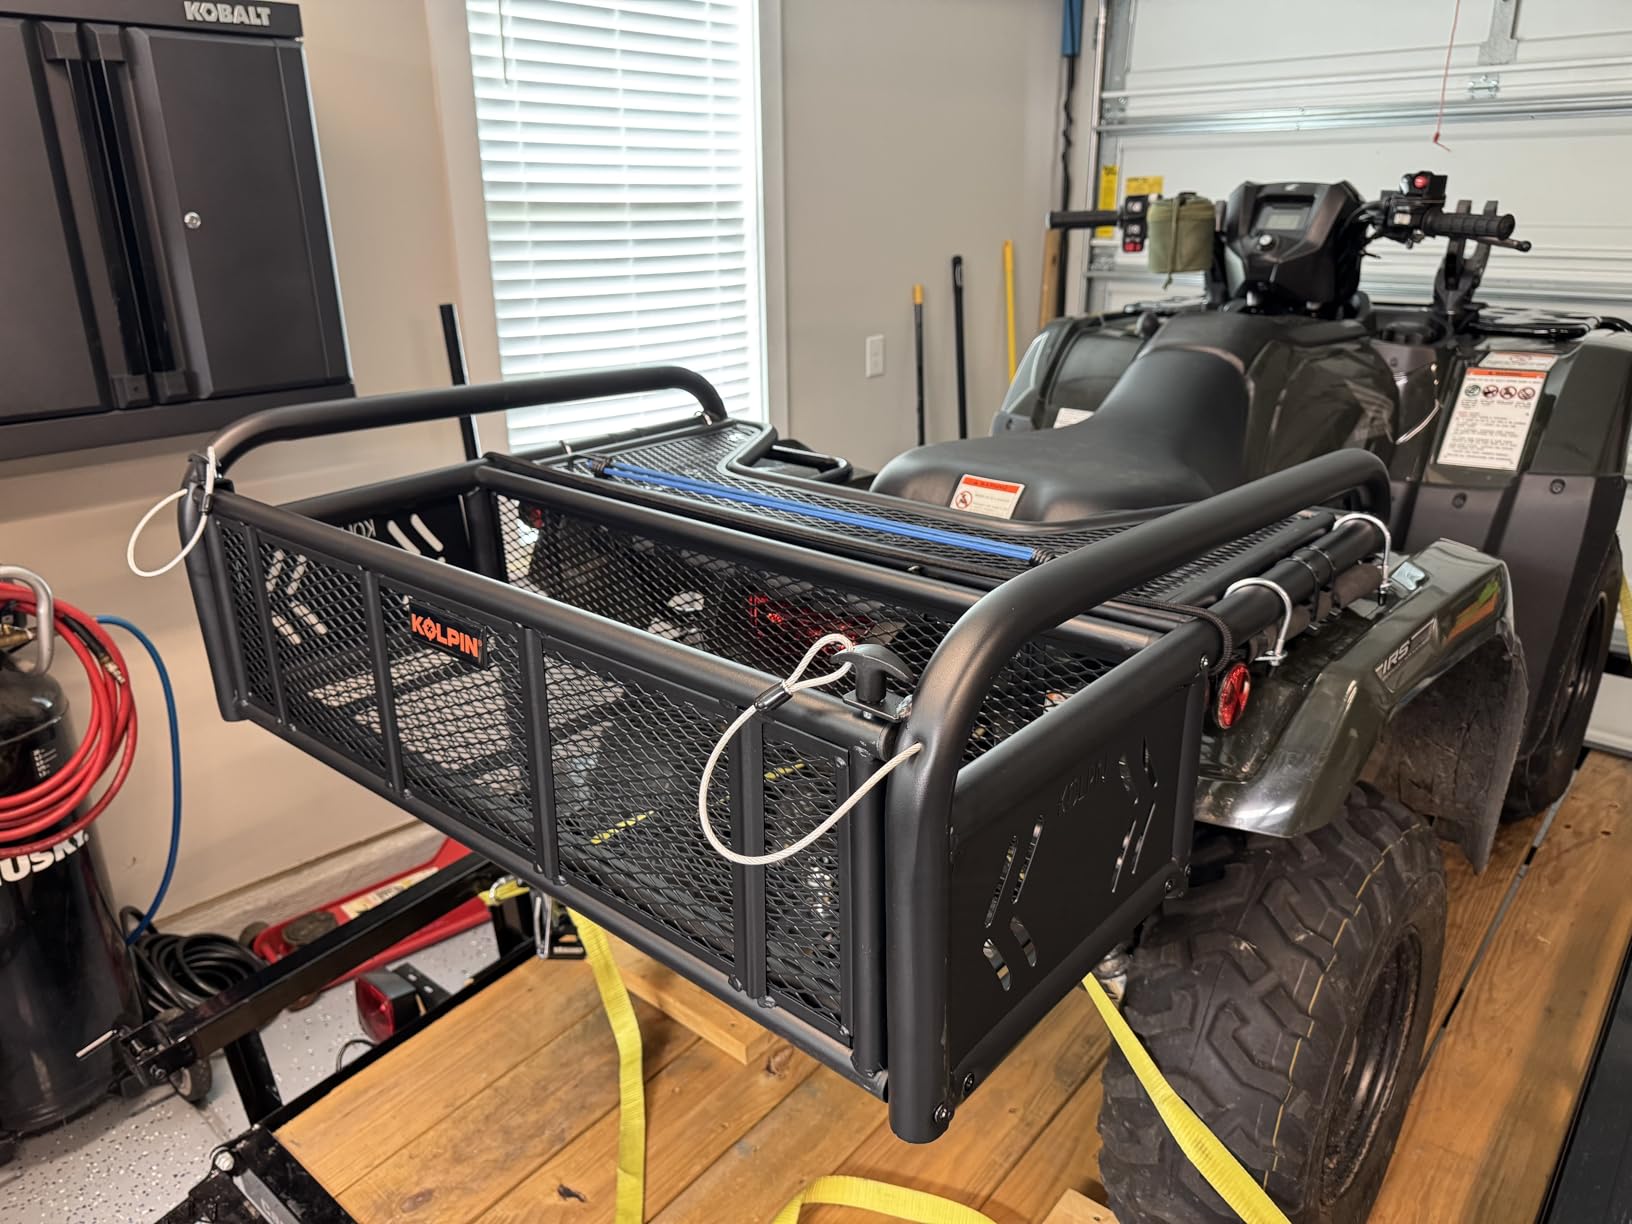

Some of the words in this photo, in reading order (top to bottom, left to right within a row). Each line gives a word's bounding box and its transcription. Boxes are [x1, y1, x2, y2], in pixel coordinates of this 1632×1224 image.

[183, 0, 271, 26] KOBALT
[411, 613, 479, 658] KOLPIN
[0, 829, 84, 887] USKY
